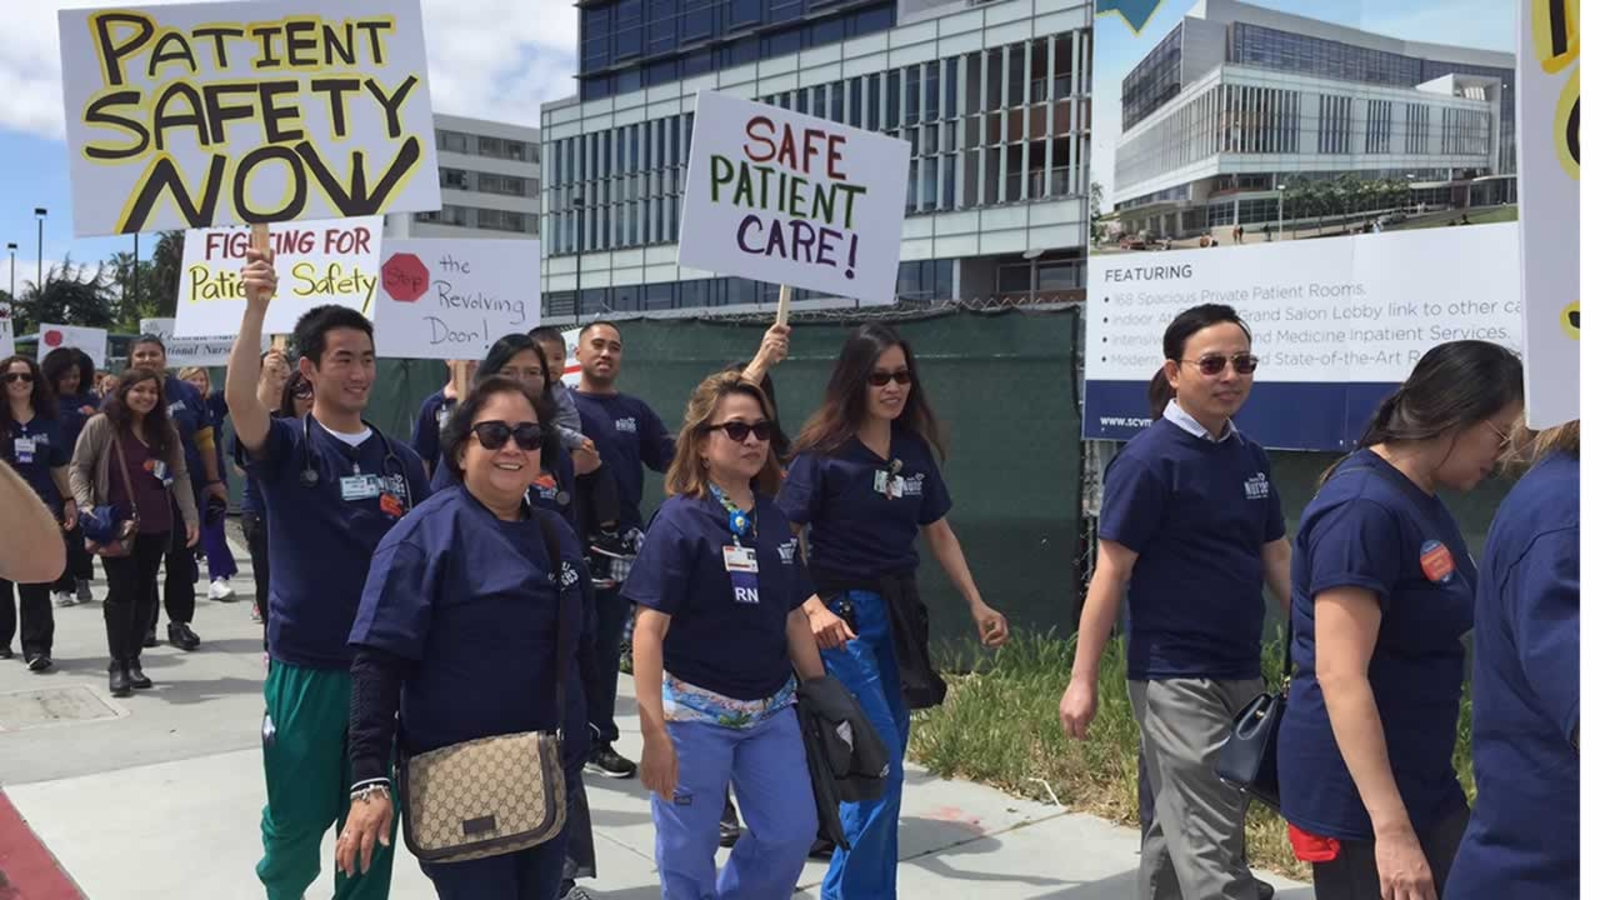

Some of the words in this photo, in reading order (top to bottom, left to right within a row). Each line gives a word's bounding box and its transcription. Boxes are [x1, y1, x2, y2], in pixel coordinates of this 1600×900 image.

[96, 13, 391, 85] PATIENT
[84, 75, 418, 159] SAFETY
[743, 116, 847, 180] SAFE
[119, 135, 421, 233] NOW
[710, 154, 867, 229] PATIENT
[205, 229, 315, 261] FIGING
[324, 226, 371, 255] FOR
[736, 214, 859, 280] CARE!
[439, 255, 471, 274] the
[1105, 264, 1193, 283] FEATURING
[190, 266, 279, 301] Patie
[291, 262, 378, 314] Safety
[432, 279, 526, 325] Revolving
[1138, 290, 1197, 306] Spacious
[1201, 288, 1249, 302] Private
[1253, 284, 1304, 300] Patient
[1309, 282, 1367, 298] Rooms.
[1238, 308, 1281, 322] Grand
[1285, 306, 1327, 321] Salon
[1333, 304, 1383, 321] Lobby
[1388, 302, 1418, 317] link
[1424, 301, 1442, 316] to
[1448, 300, 1498, 316] other
[423, 316, 489, 350] Door!
[1277, 328, 1346, 343] Medicine
[1350, 326, 1423, 343] Inpatient
[1430, 324, 1511, 341] Services.
[1275, 350, 1401, 366] State-of-the-Art
[1099, 416, 1153, 428] www.scvm
[734, 586, 760, 603] RN
